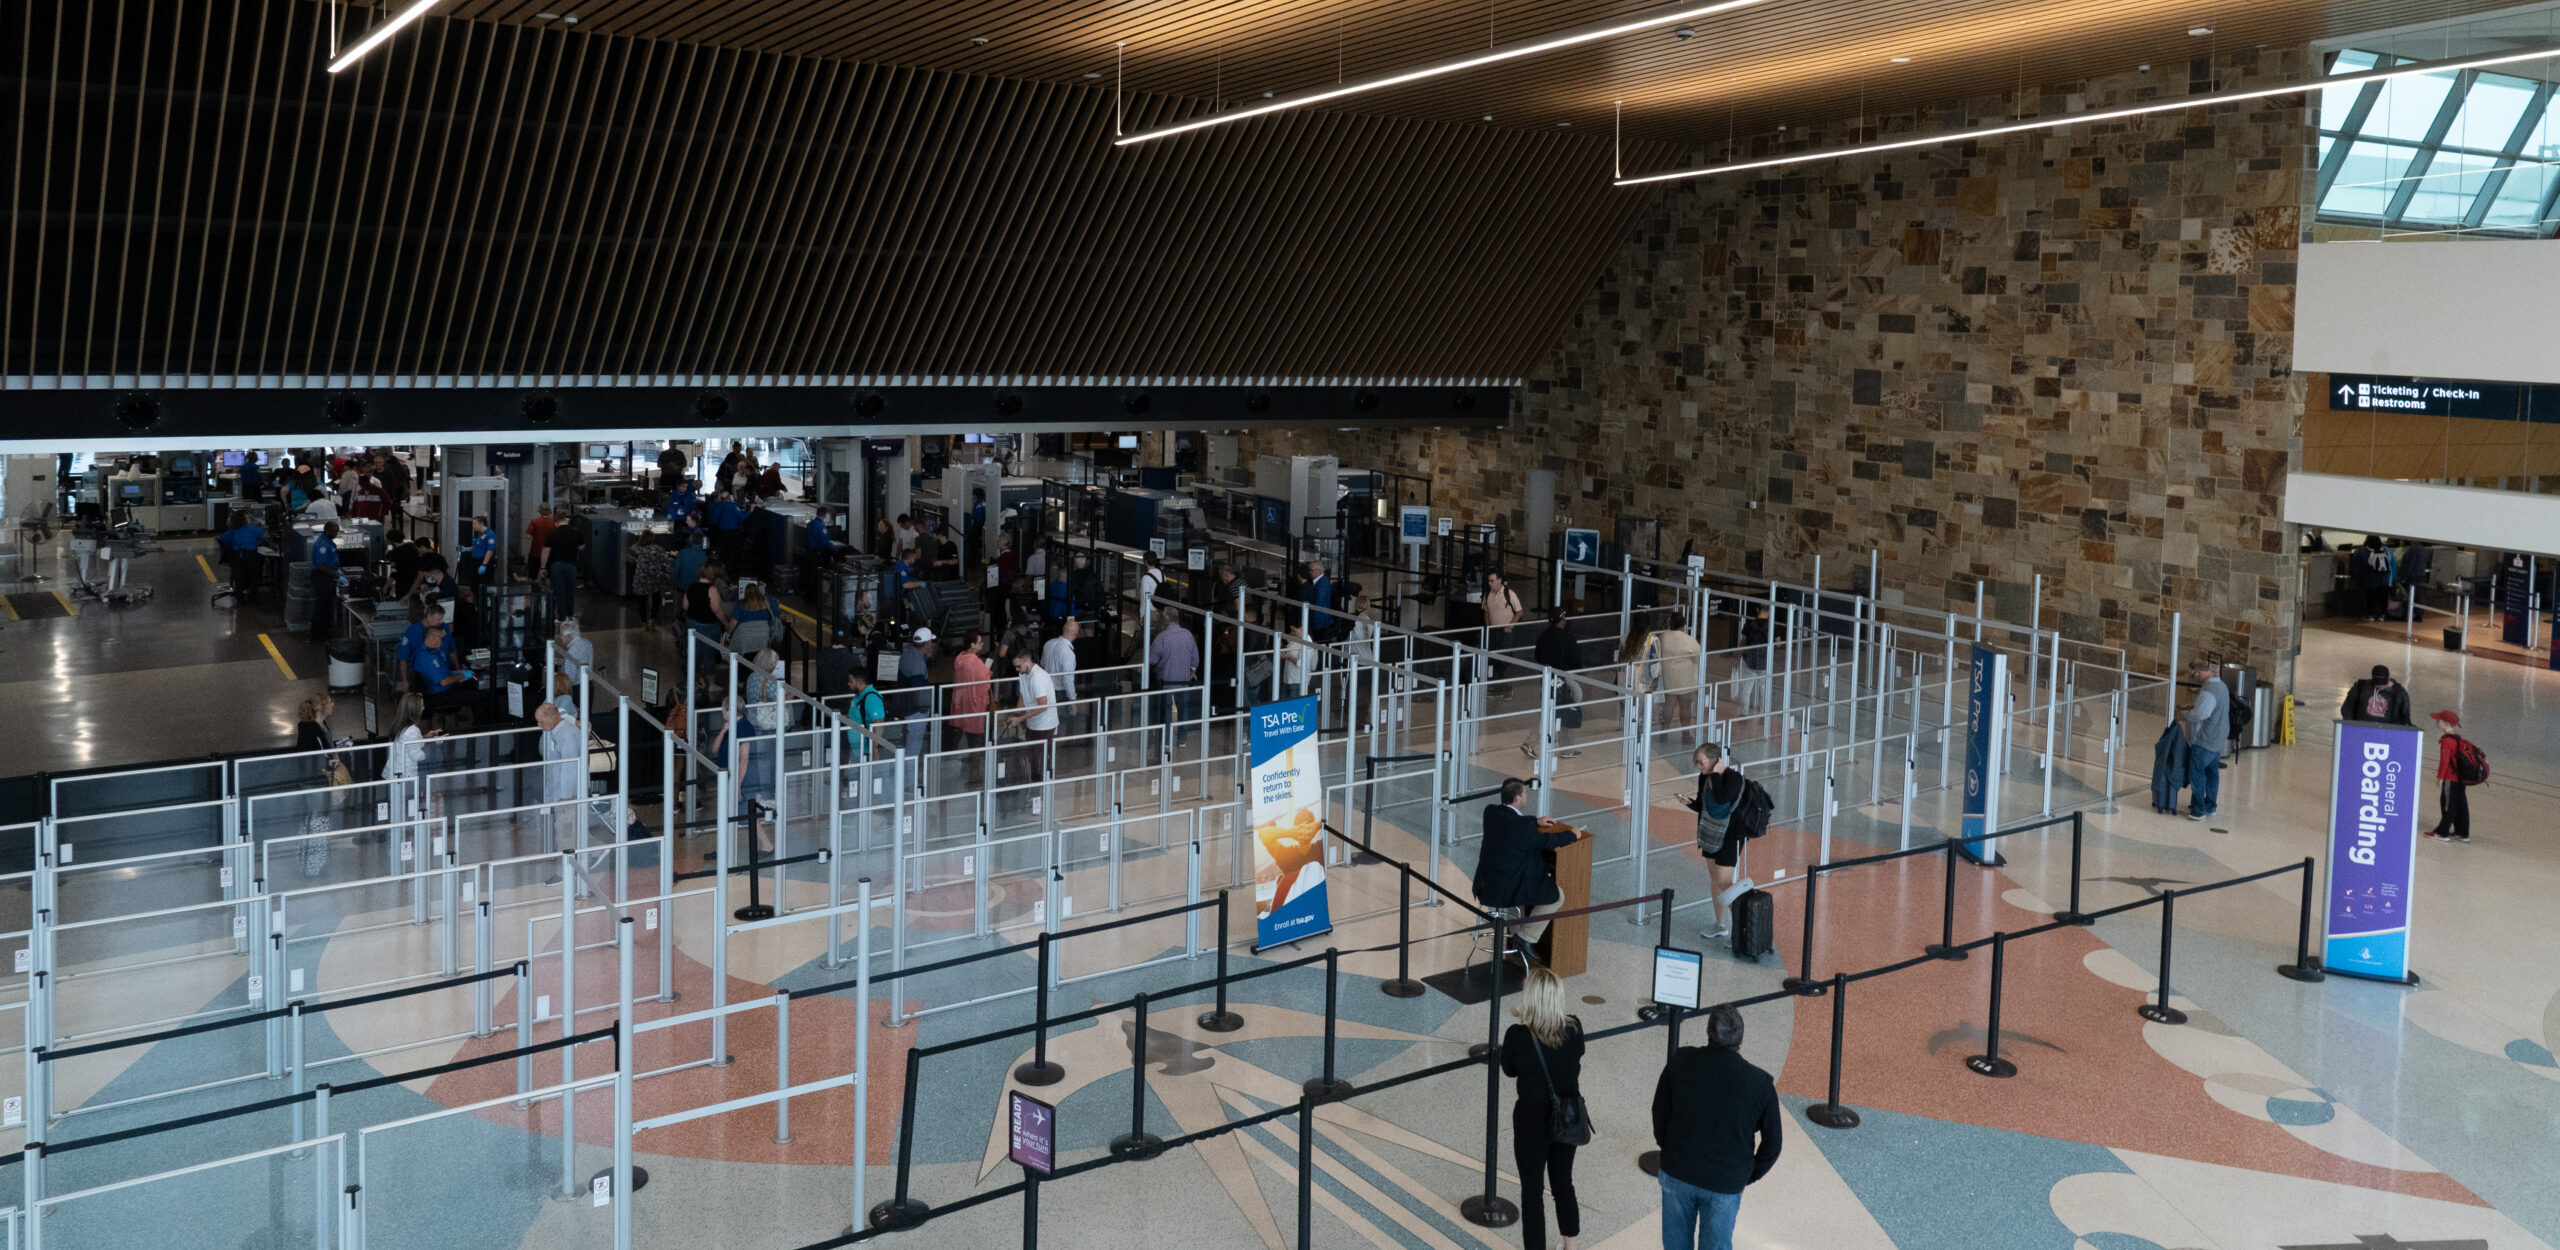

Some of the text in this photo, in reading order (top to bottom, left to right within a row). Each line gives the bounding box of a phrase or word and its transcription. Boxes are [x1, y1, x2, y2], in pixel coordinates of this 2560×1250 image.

[2372, 384, 2419, 398] Ticketing
[2432, 388, 2480, 400] Check-In
[2372, 397, 2426, 409] Restrooms
[1971, 658, 1983, 732] TSA Pre
[1261, 712, 1298, 729] TSA Pre
[1264, 724, 1305, 739] Travel With Ease
[1262, 767, 1301, 783] Confidently
[1263, 780, 1292, 794] return to
[2384, 760, 2402, 817] General
[1264, 791, 1294, 804] the skies.
[2349, 741, 2390, 866] Boarding
[1274, 920, 1290, 931] Enroll
[1296, 914, 1314, 925] tsa.gov
[1014, 1096, 1022, 1150] BE READY
[1022, 1130, 1048, 1146] when it's
[1022, 1138, 1036, 1148] your
